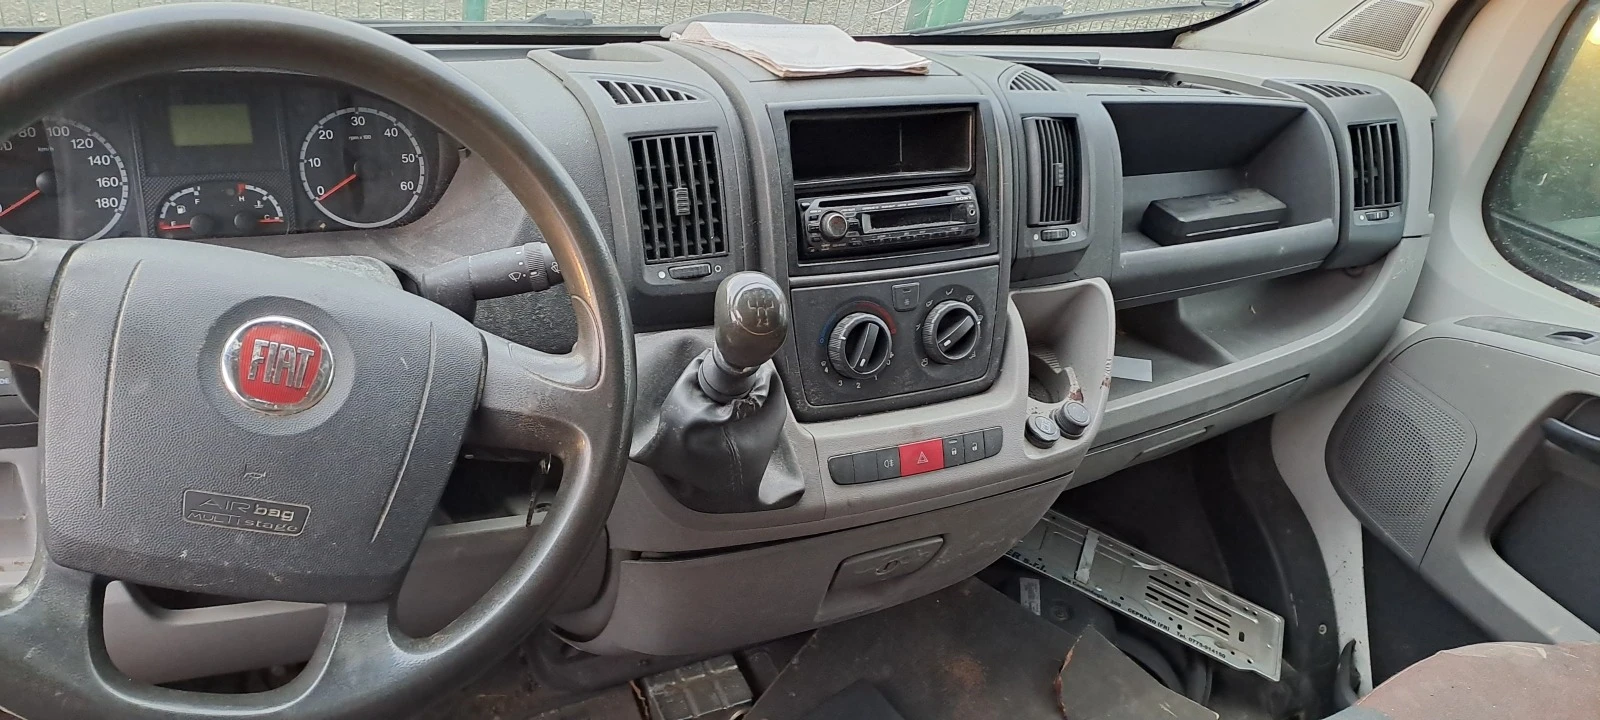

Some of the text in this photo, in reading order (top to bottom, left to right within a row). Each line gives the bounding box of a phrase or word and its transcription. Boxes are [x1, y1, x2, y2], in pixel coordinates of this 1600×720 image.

[350, 116, 366, 126] 30
[47, 126, 70, 137] 100
[318, 129, 334, 140] 20
[384, 127, 399, 138] 40
[70, 138, 94, 149] 120
[88, 154, 111, 166] 140
[308, 157, 321, 168] 10
[401, 153, 415, 163] 50
[96, 176, 119, 188] 160
[400, 181, 414, 191] 60
[316, 185, 325, 196] 0
[95, 197, 119, 209] 180
[247, 337, 315, 390] FIAT
[1127, 607, 1157, 625] CEPRANO
[1176, 631, 1187, 641] Tel.
